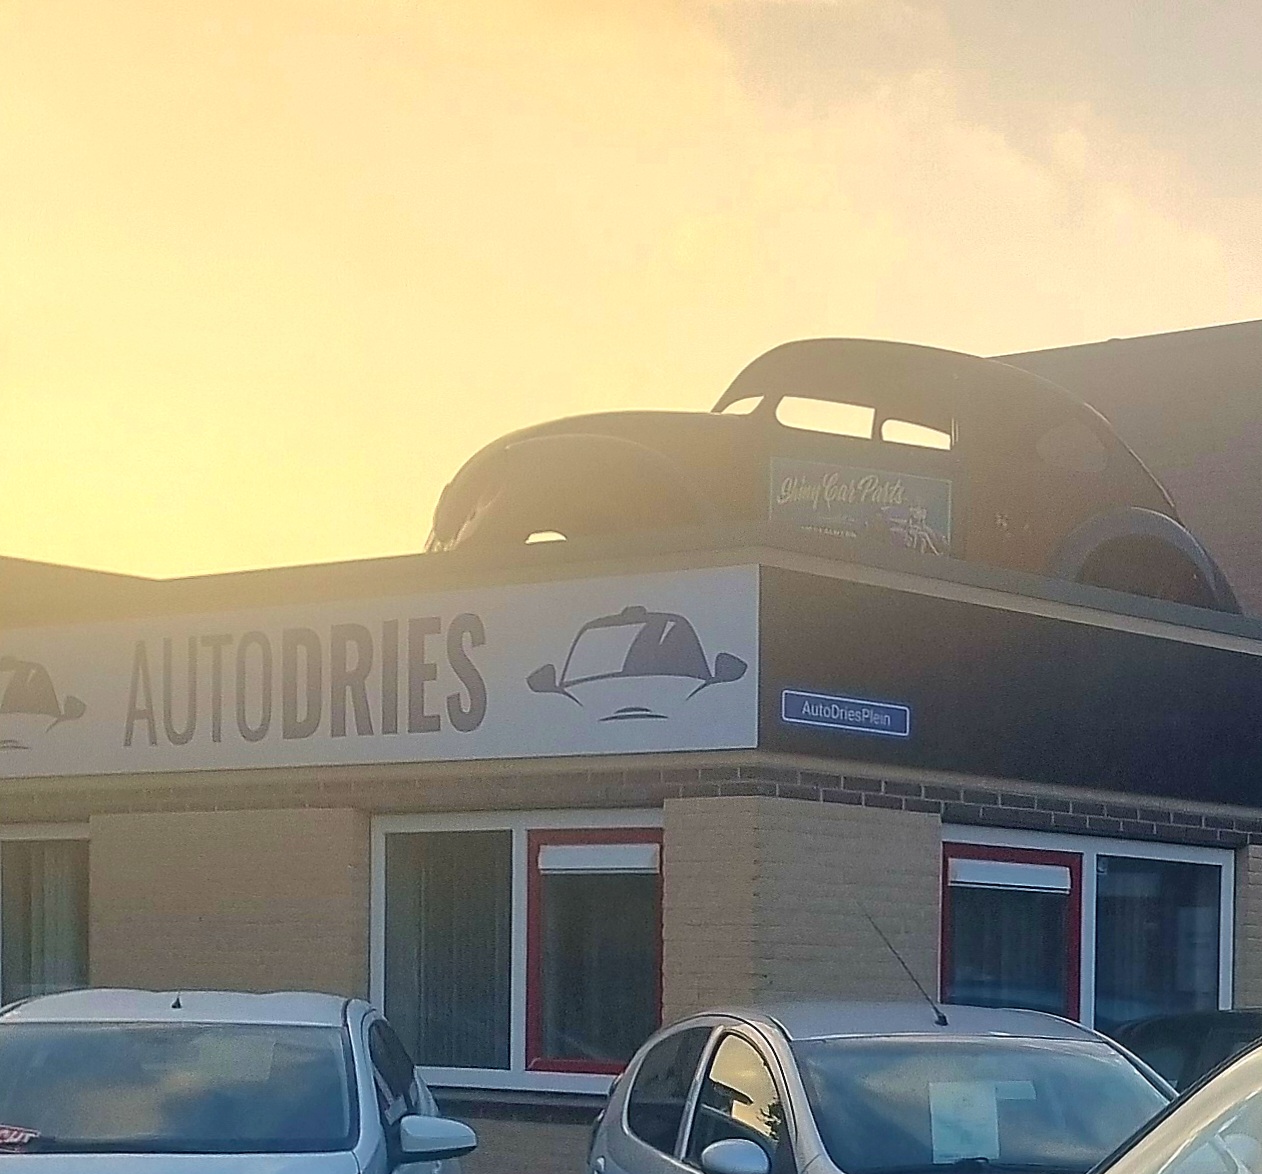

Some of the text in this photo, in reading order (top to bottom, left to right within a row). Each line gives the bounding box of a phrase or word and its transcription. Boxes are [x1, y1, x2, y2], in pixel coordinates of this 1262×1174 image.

[822, 472, 857, 510] Car
[857, 474, 905, 505] Parts
[123, 613, 488, 747] AUTODRIES
[801, 700, 891, 727] AutoDriesPlein
